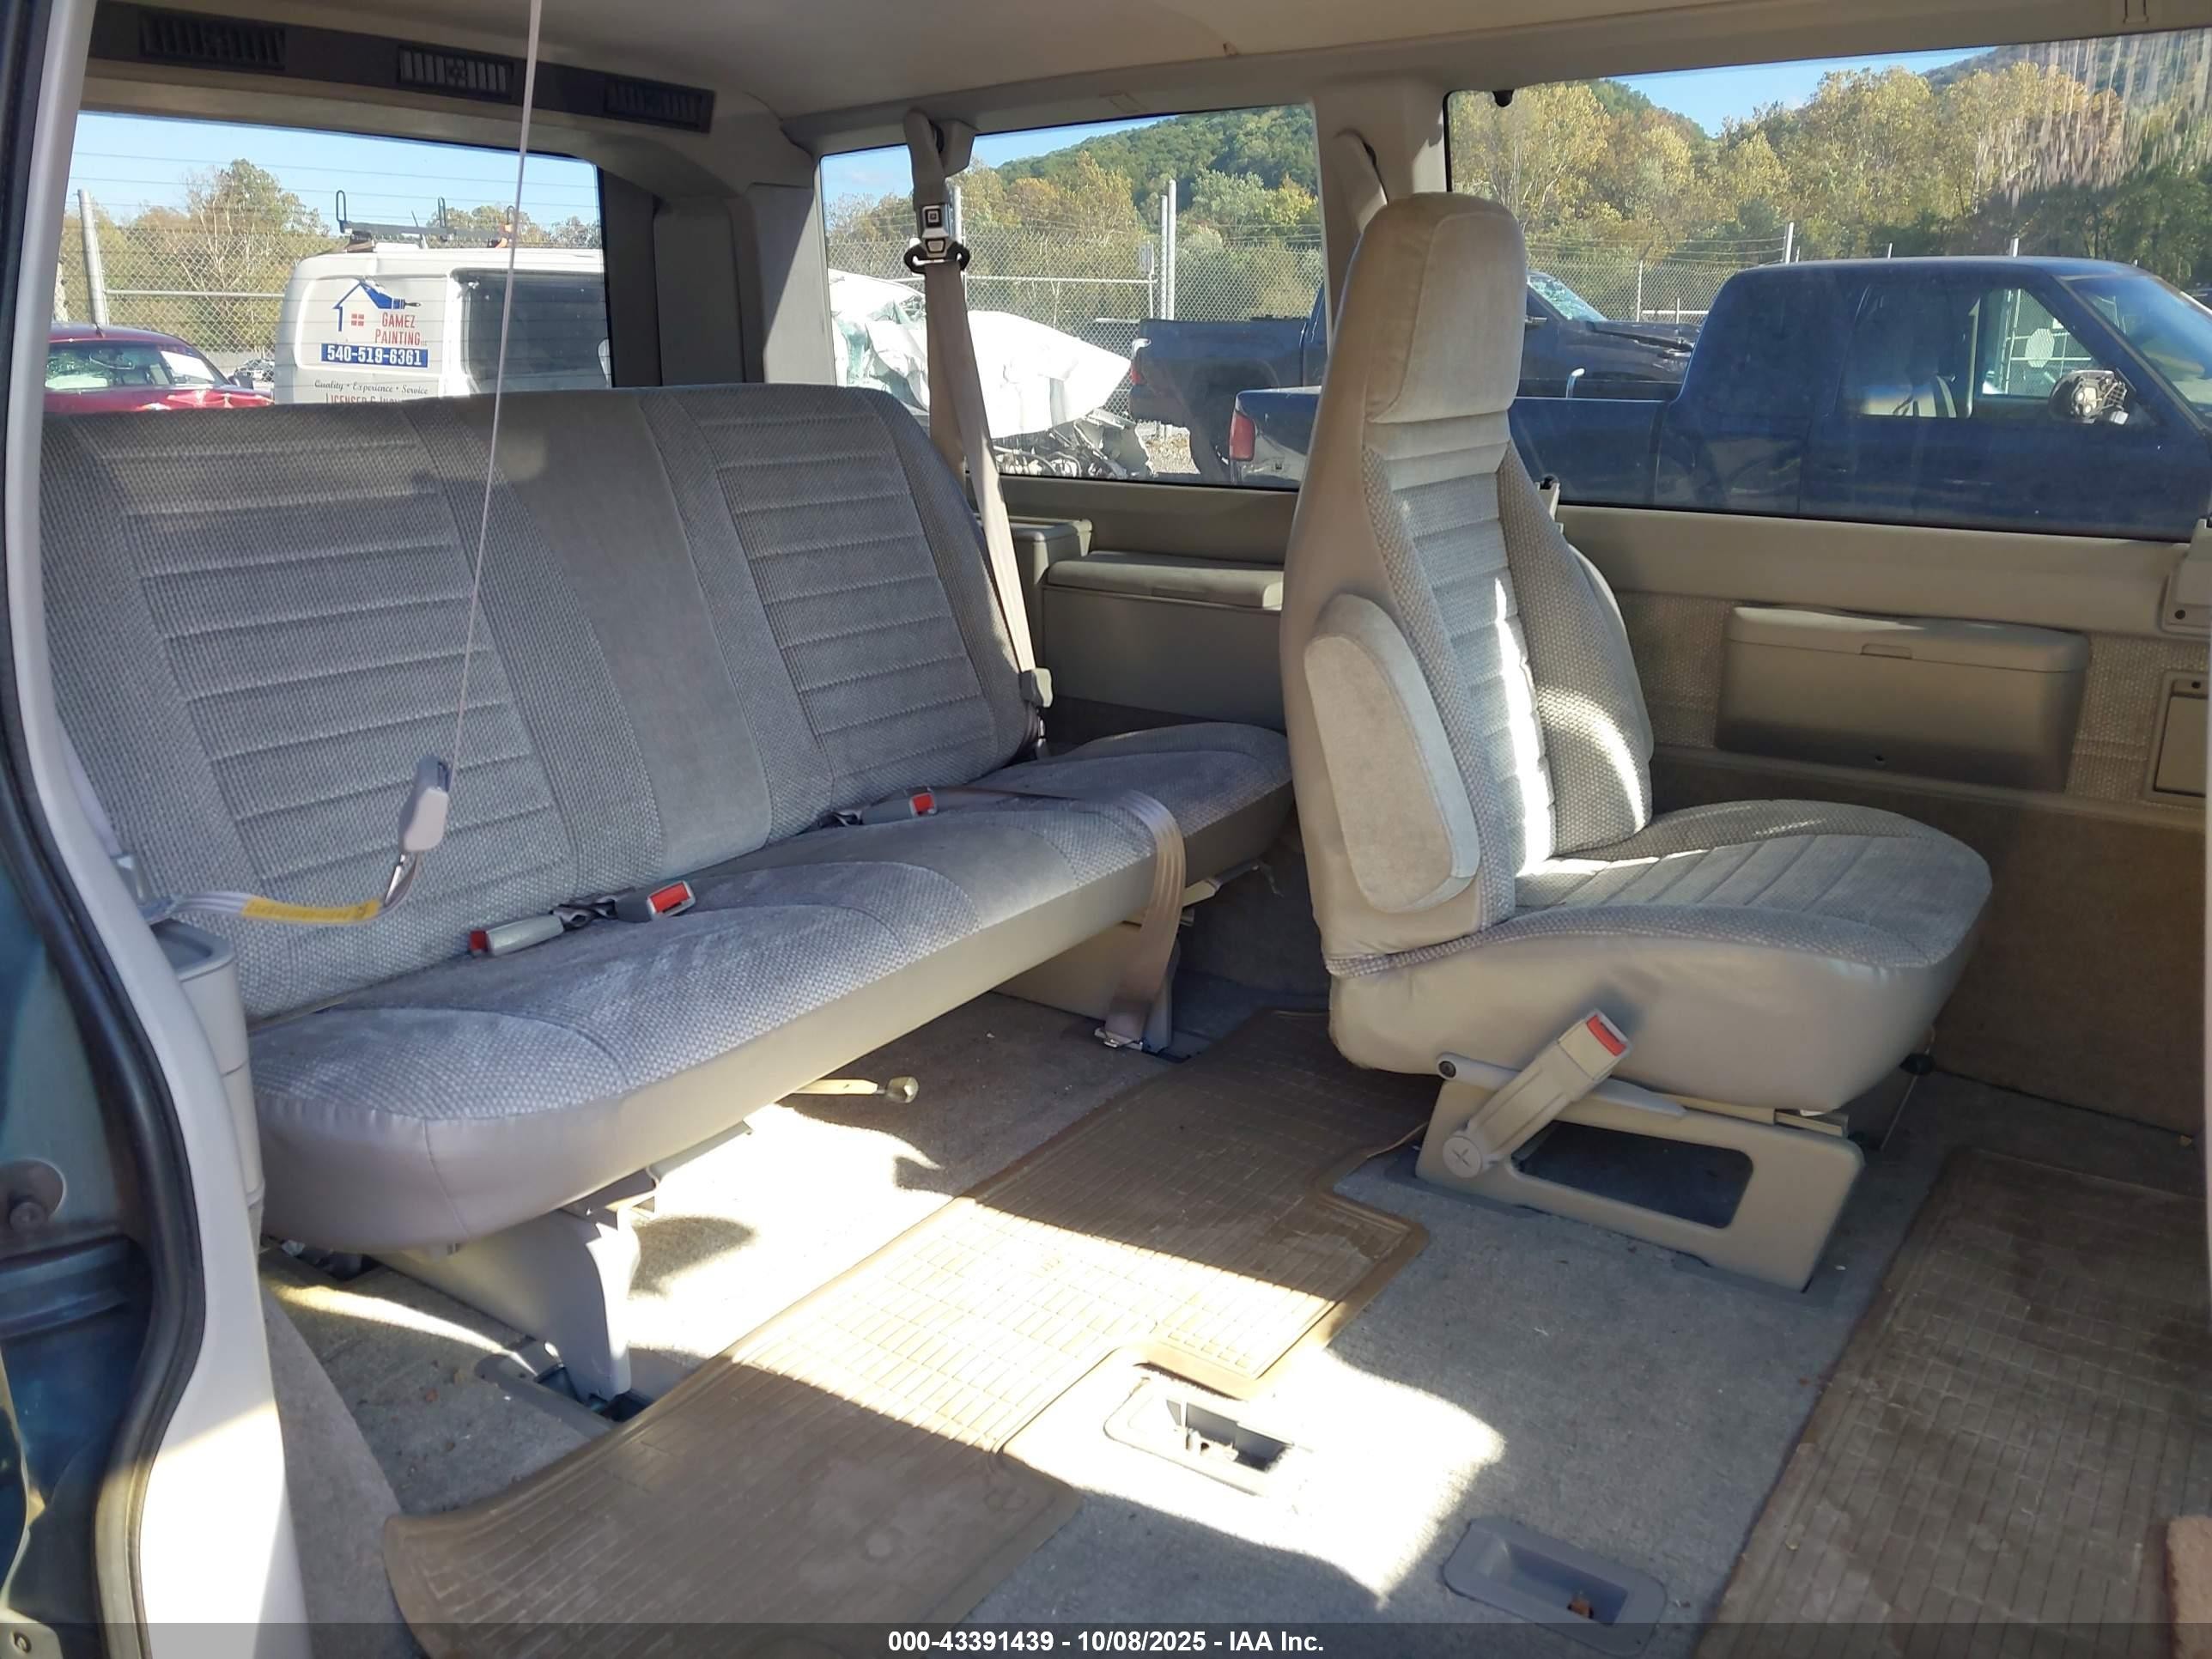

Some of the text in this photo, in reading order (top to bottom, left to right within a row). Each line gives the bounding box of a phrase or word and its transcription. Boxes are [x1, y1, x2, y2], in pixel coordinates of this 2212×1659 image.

[382, 312, 416, 328] GAMEZ
[374, 329, 421, 346] PAINTING
[327, 344, 422, 366] 540-519-6361
[314, 379, 428, 395] Quality Experience Service
